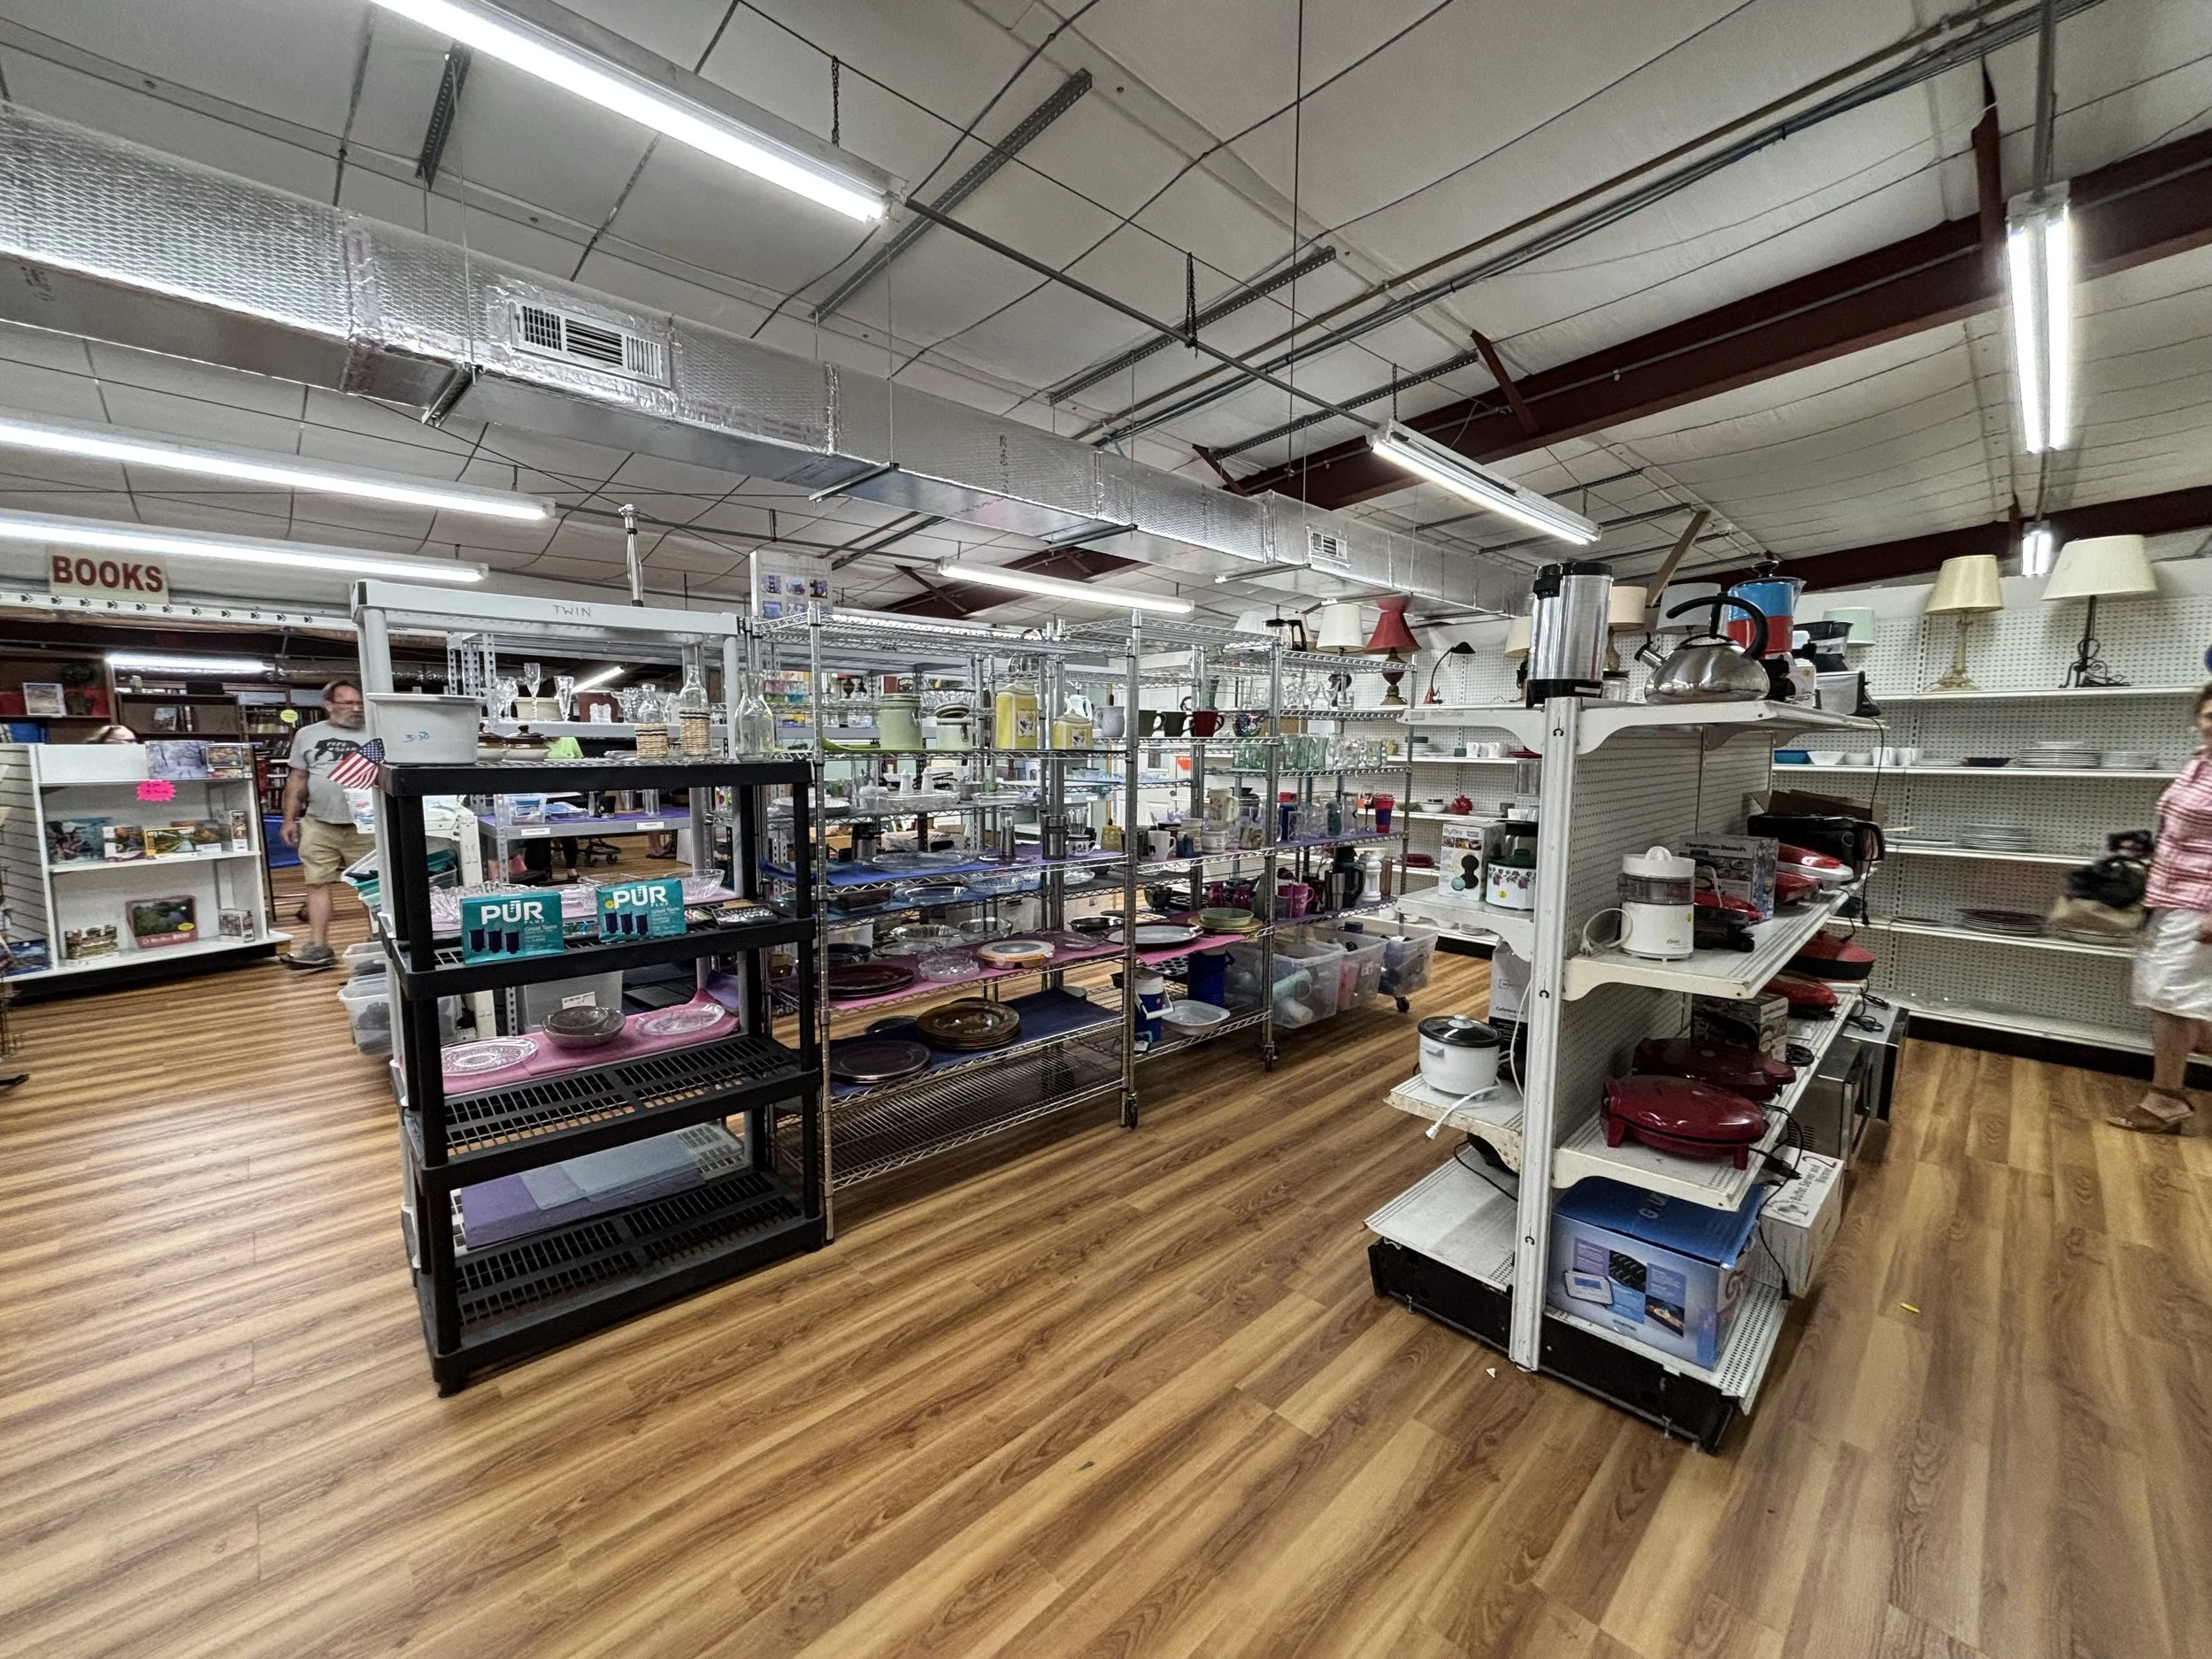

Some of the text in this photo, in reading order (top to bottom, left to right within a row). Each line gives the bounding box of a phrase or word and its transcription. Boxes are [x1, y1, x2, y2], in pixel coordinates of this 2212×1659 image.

[51, 555, 164, 593] BOOKS
[552, 604, 591, 617] TWIN
[1685, 841, 1720, 850] Hamilton
